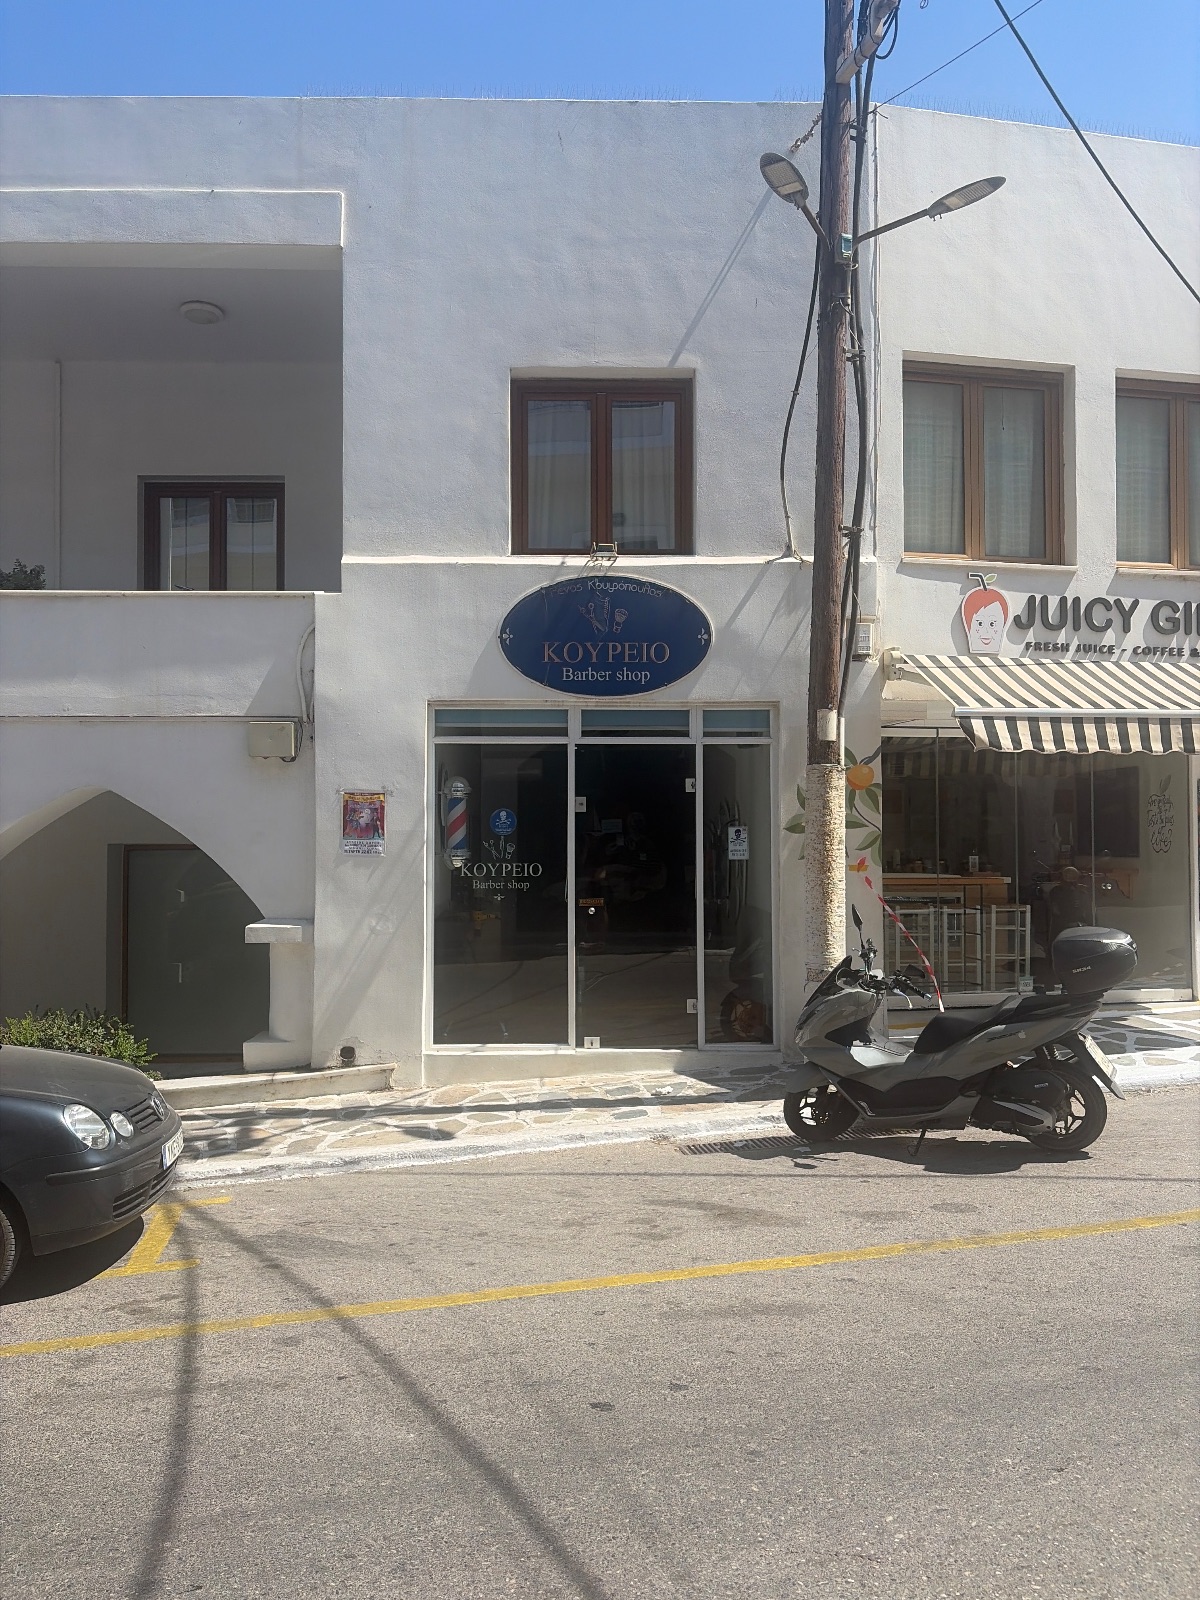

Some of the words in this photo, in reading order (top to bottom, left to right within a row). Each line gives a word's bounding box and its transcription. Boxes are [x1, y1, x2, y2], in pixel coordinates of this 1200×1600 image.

[1013, 594, 1140, 633] JUICY
[541, 641, 670, 664] ΚΟΥΡΕΙΟ
[1025, 641, 1070, 653] FRESH
[1075, 643, 1116, 655] JUICE
[1132, 645, 1186, 657] COFFEE
[562, 667, 612, 681] Barber
[616, 667, 651, 684] shop
[460, 862, 543, 877] ΚΟΥΡΕΙΟ
[472, 880, 505, 889] Barber
[507, 880, 530, 891] shop
